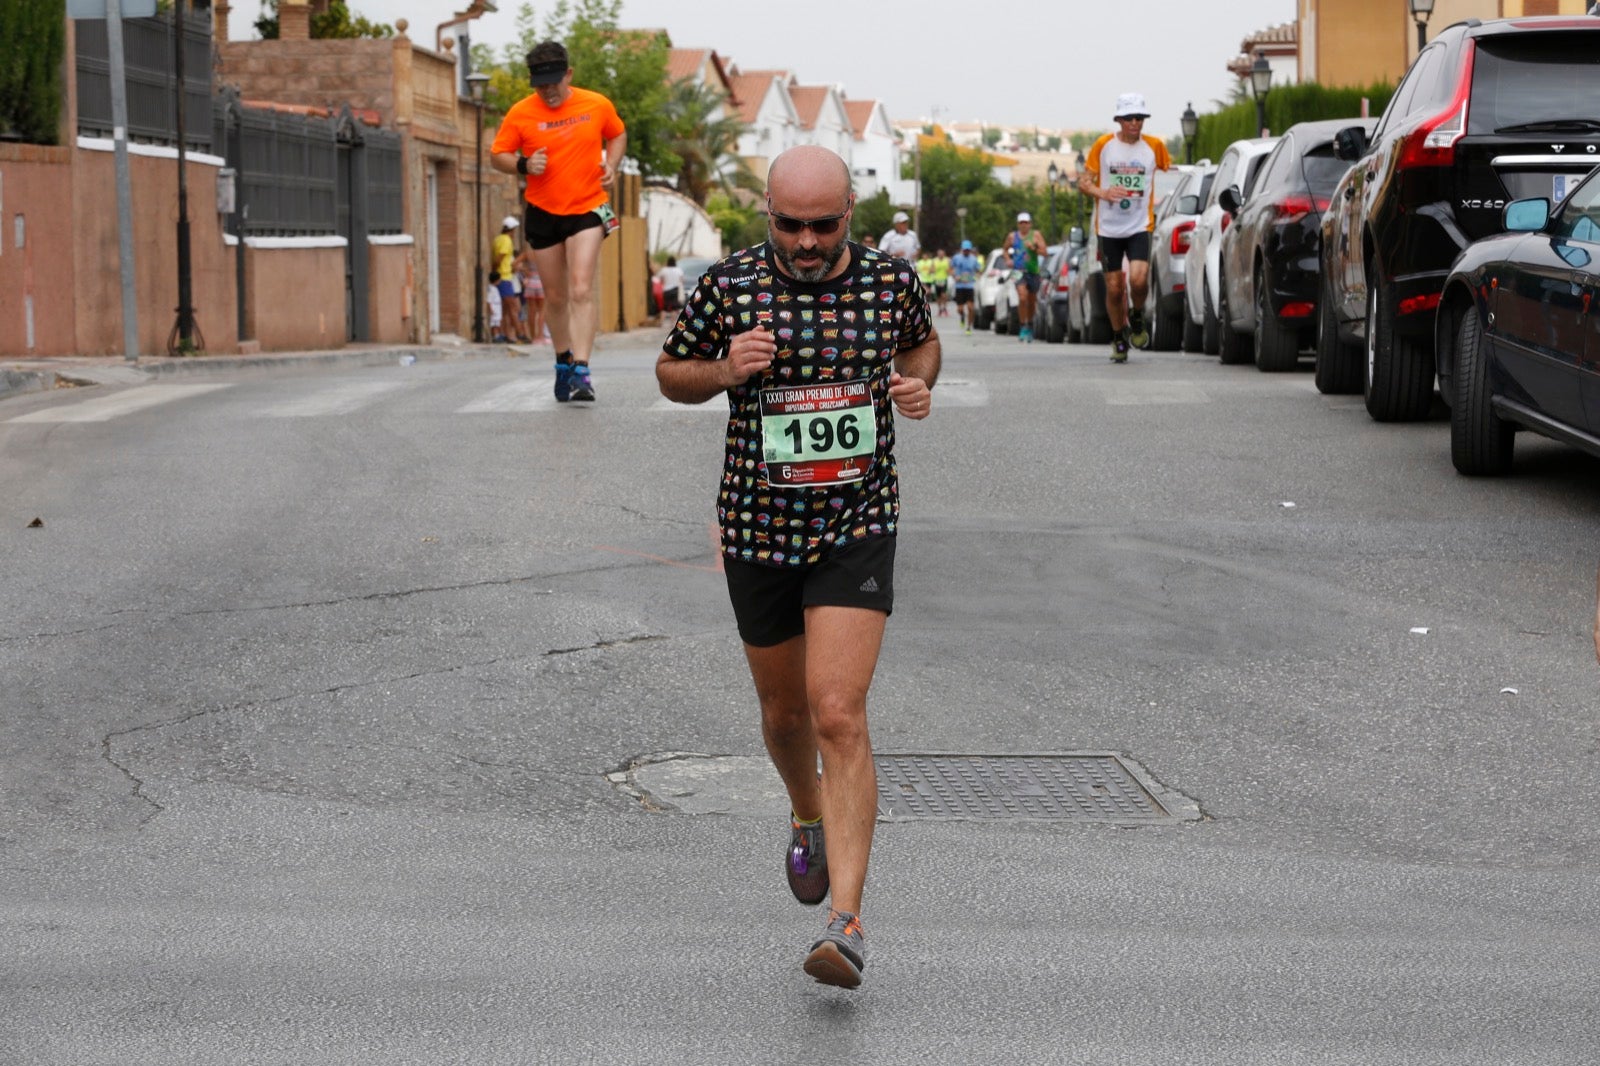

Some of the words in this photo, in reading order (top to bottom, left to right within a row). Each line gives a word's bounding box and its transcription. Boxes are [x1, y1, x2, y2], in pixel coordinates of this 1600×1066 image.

[1116, 176, 1141, 188] 392
[785, 389, 805, 402] GRAN
[806, 387, 833, 401] PREMIO
[835, 386, 843, 398] DE
[844, 383, 865, 397] FONDO
[819, 399, 850, 410] CRUZCAMPO
[784, 414, 860, 454] 196
